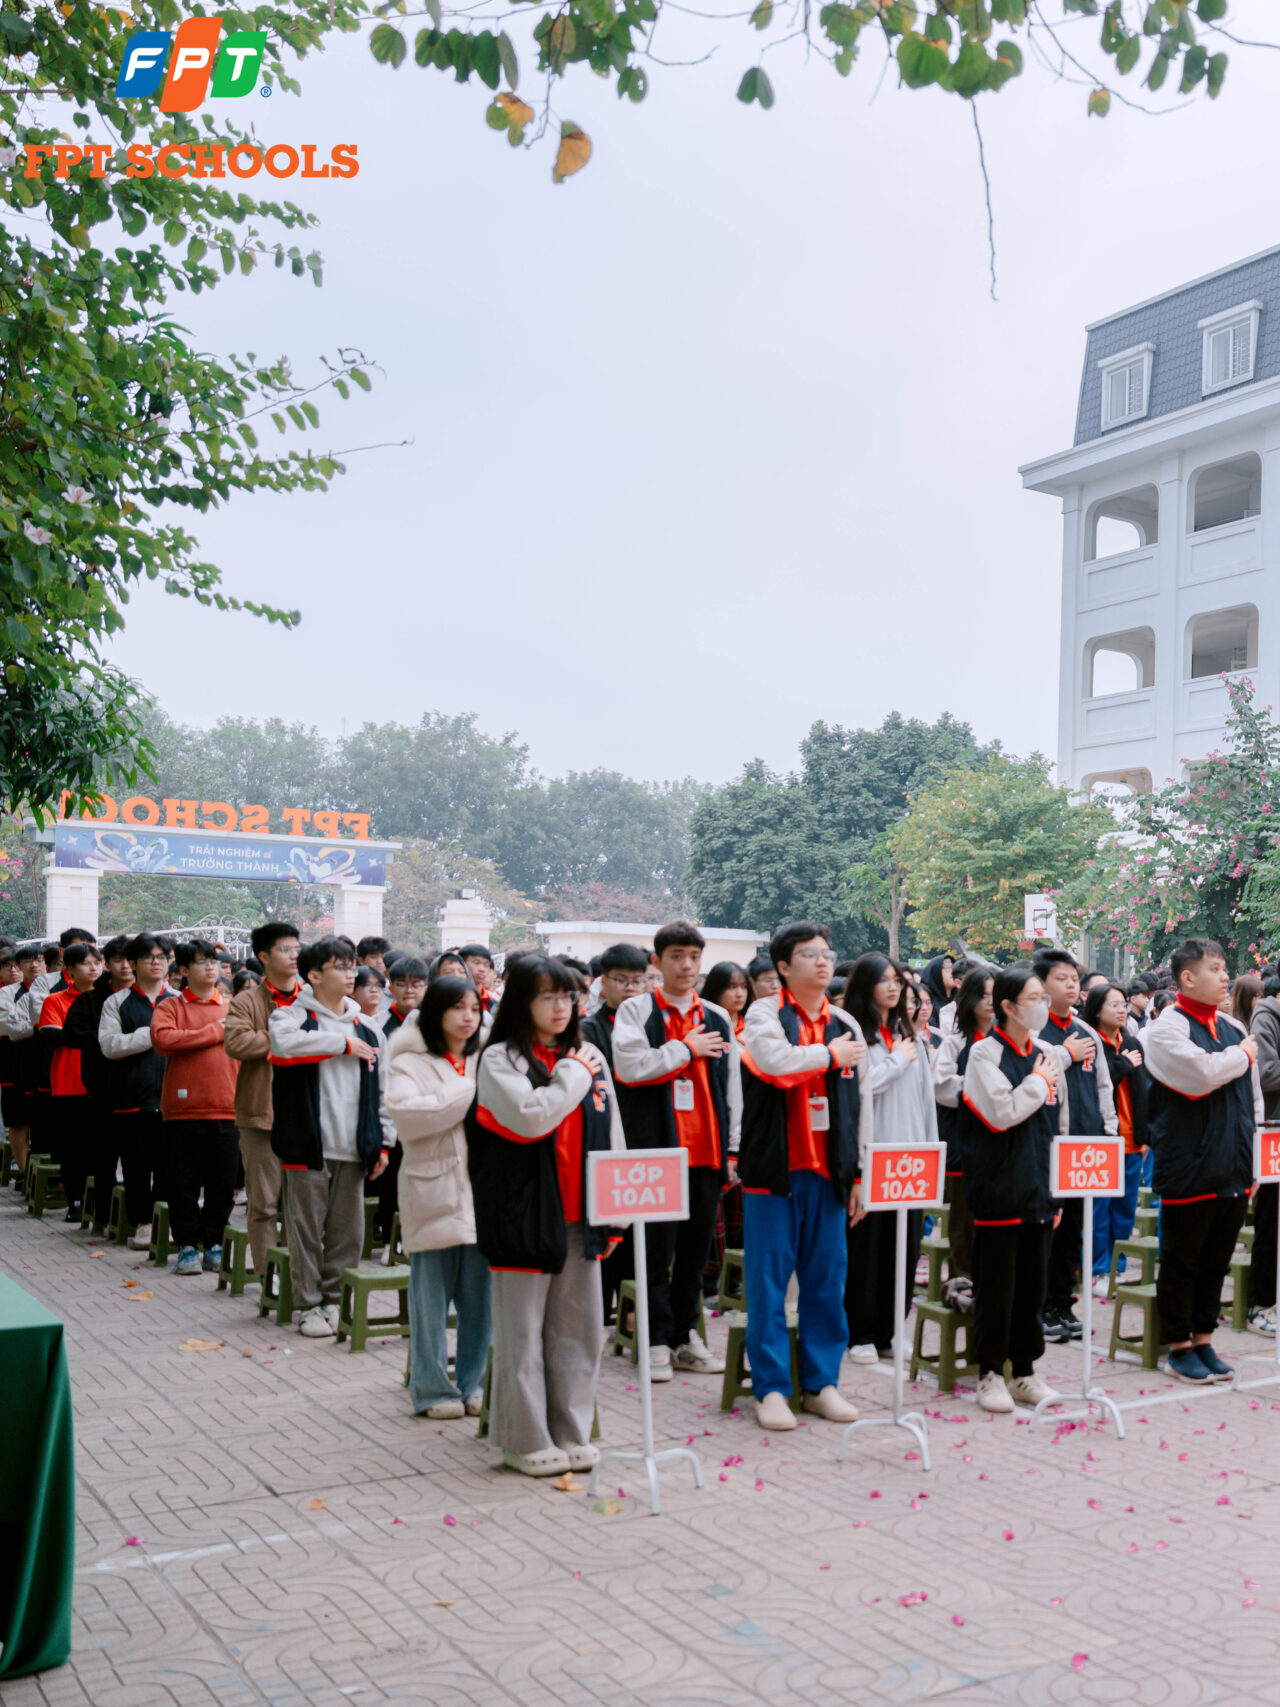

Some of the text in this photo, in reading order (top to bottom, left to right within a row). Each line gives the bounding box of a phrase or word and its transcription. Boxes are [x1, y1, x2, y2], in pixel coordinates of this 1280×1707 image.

[885, 1154, 926, 1179] LỚP
[1071, 1145, 1108, 1168] LỚP
[613, 1163, 664, 1186] LỚP
[1067, 1169, 1110, 1188] 10A3
[611, 1186, 665, 1207] 10A1
[880, 1179, 927, 1199] 10A2
